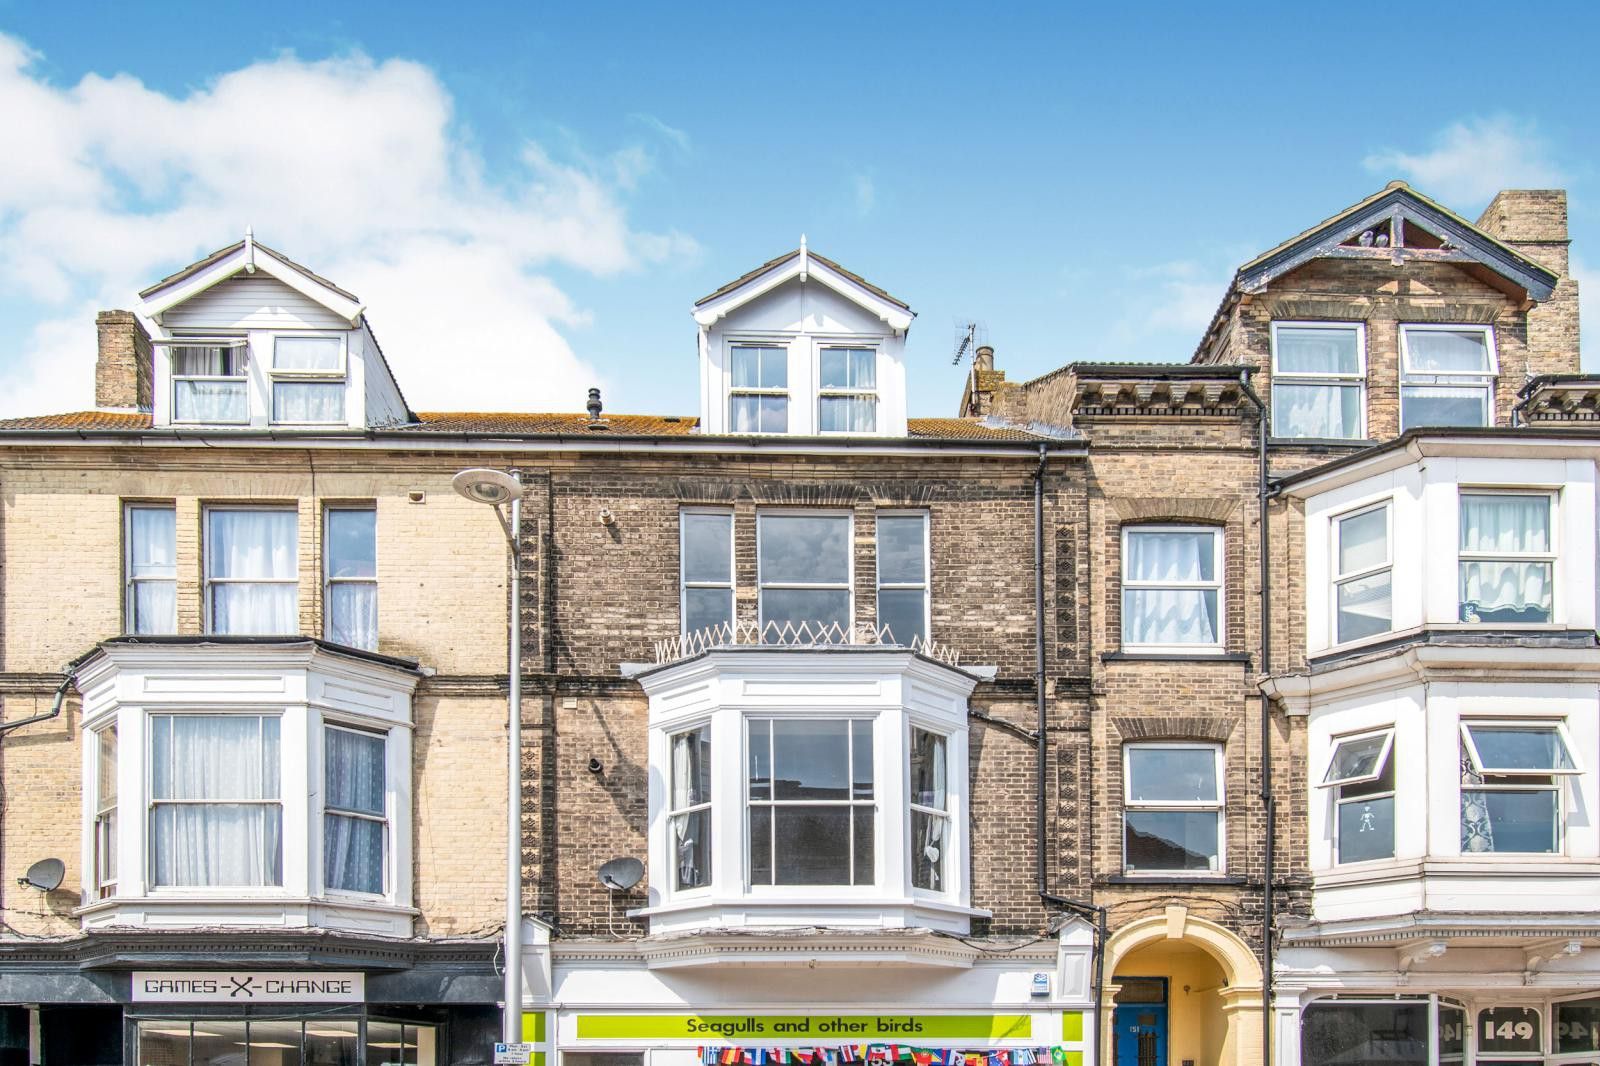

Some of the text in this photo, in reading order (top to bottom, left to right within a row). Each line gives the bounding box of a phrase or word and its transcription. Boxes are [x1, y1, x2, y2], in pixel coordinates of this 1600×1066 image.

[687, 1018, 923, 1036] Seagulls and other birds
[1485, 1021, 1534, 1040] 149
